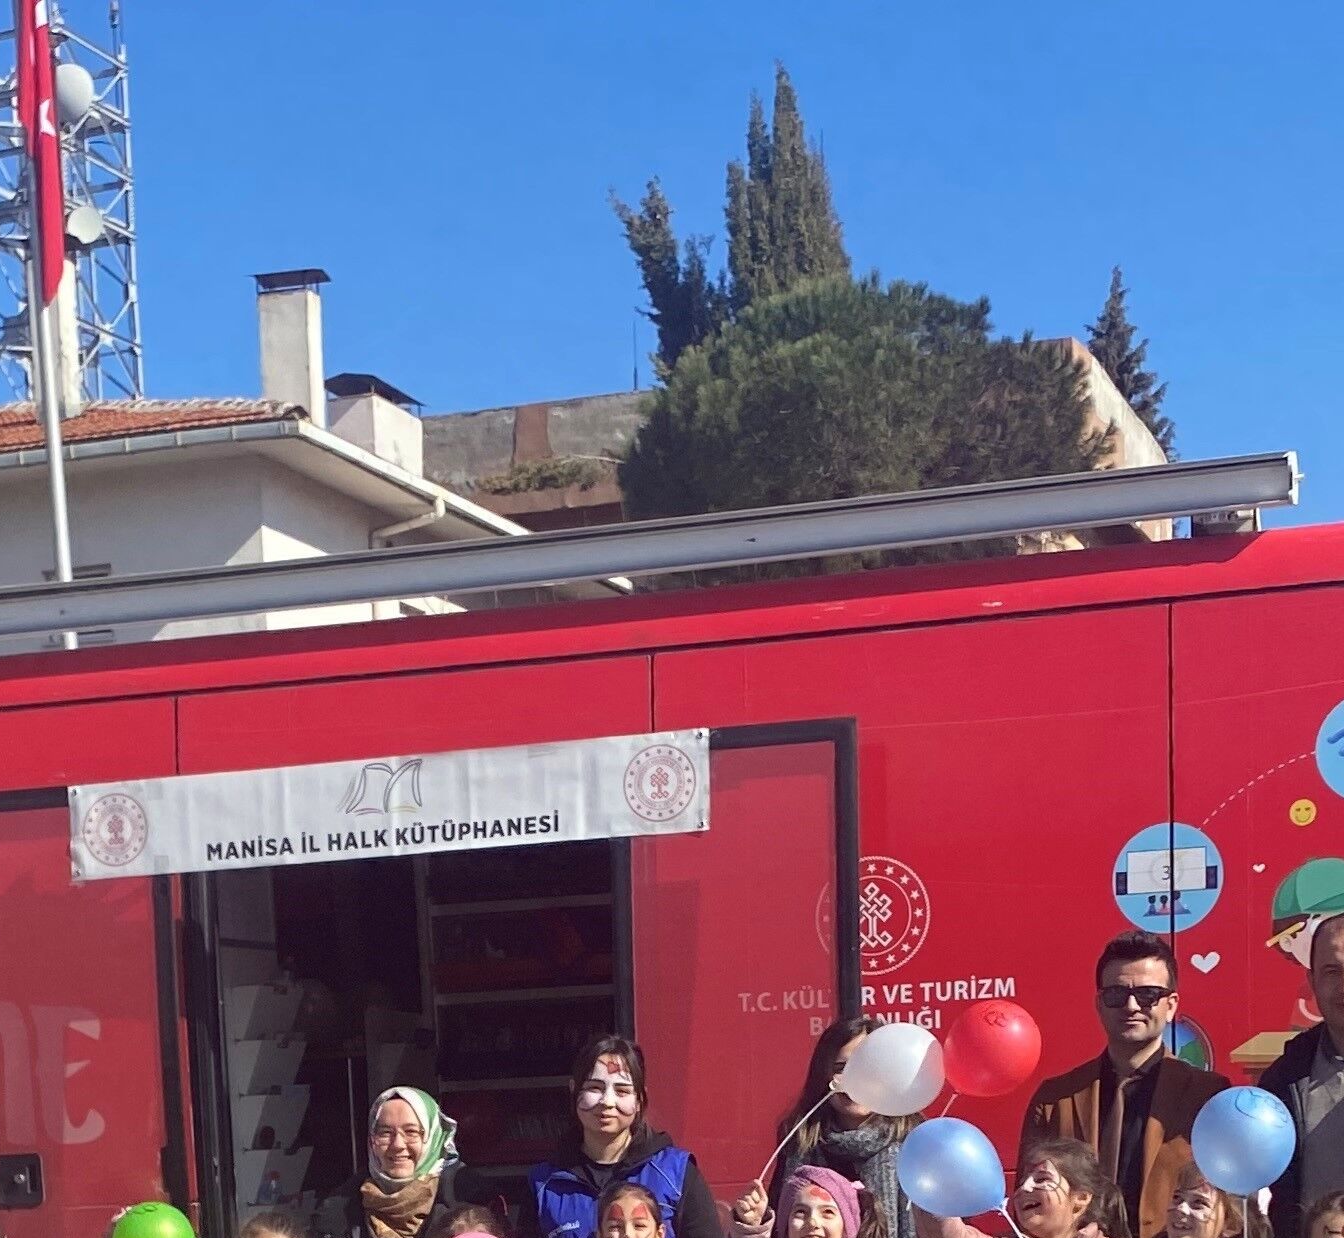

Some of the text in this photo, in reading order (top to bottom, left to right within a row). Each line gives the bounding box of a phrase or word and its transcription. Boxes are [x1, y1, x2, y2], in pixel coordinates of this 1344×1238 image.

[206, 809, 560, 862] MANİSA İL HALK KÜTÜPHANESİ
[738, 975, 1016, 1013] T.C. KÜLR VE TURİZM
